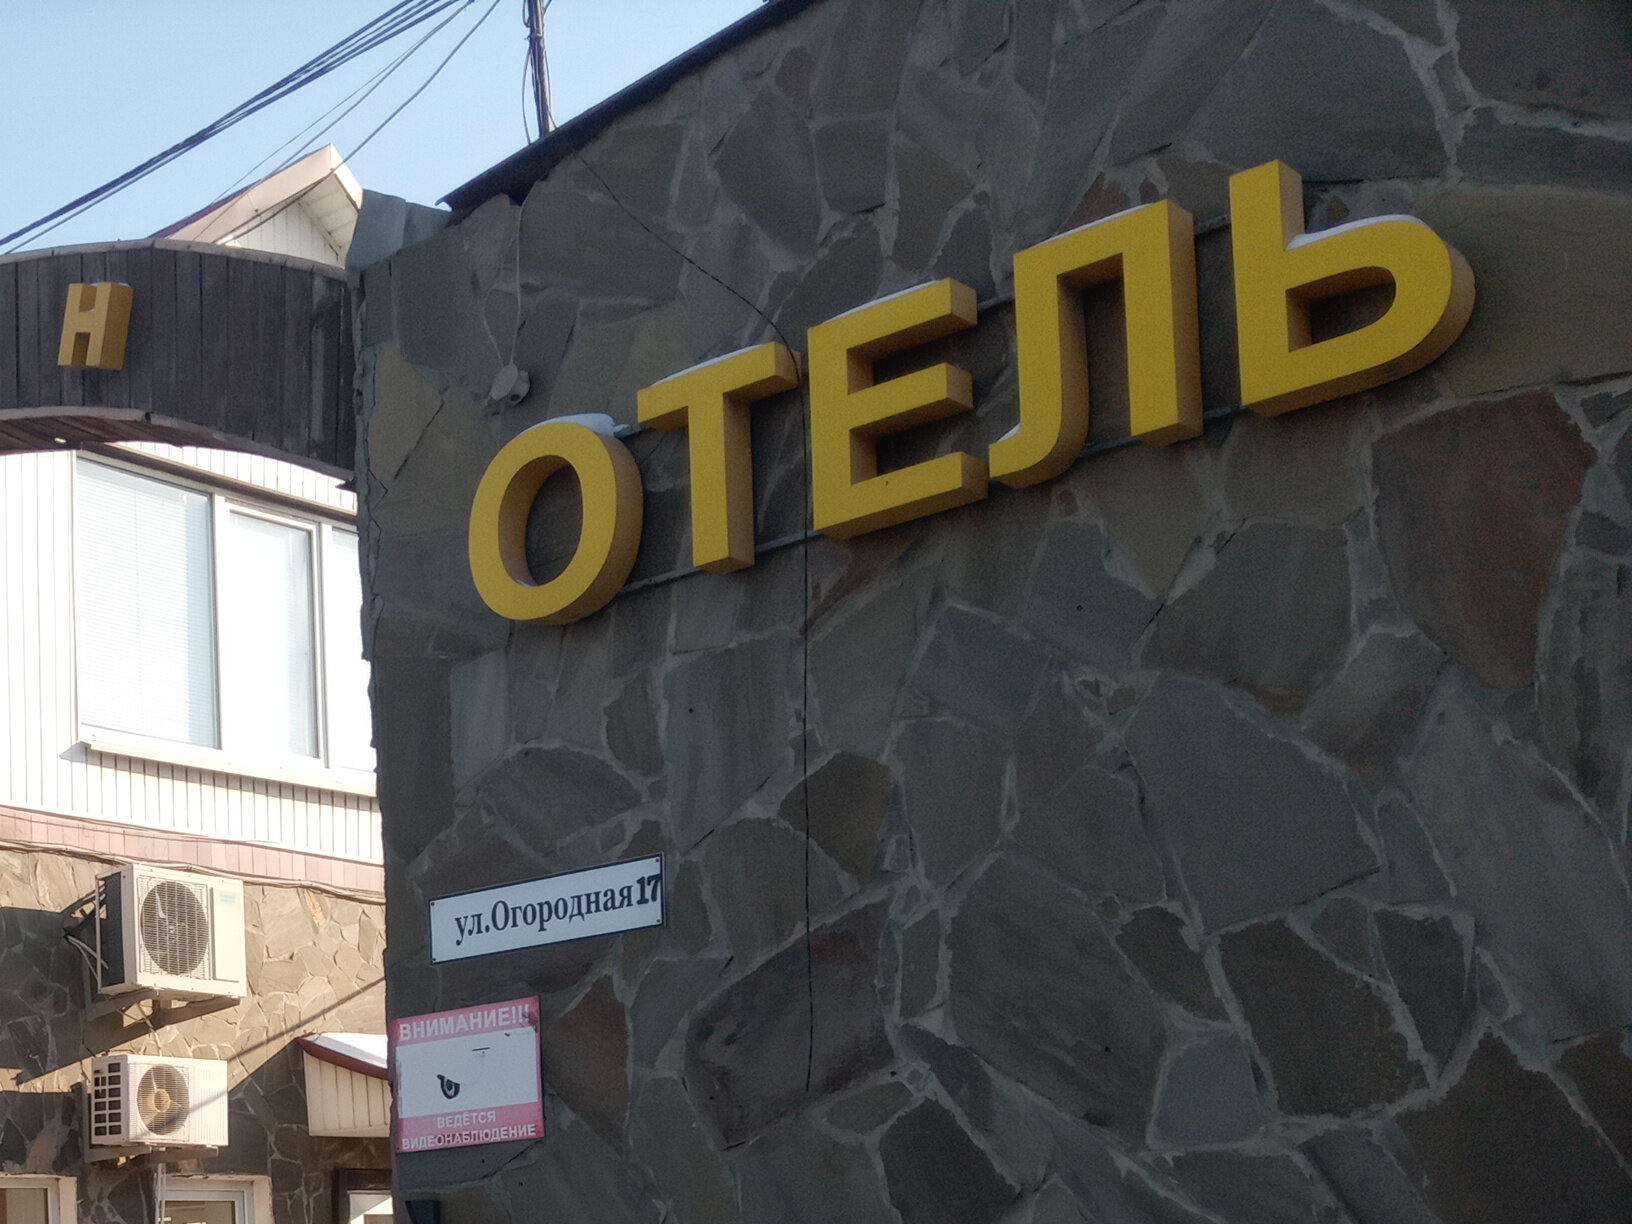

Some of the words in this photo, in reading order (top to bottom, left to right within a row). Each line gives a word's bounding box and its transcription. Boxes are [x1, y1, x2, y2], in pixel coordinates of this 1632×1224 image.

[467, 159, 1476, 626] ОТЕЛЬ
[399, 1004, 530, 1041] ВНИМАНИЕ!!!
[402, 1123, 536, 1150] ВИДЕОНАБЛЮДЕНИЕ
